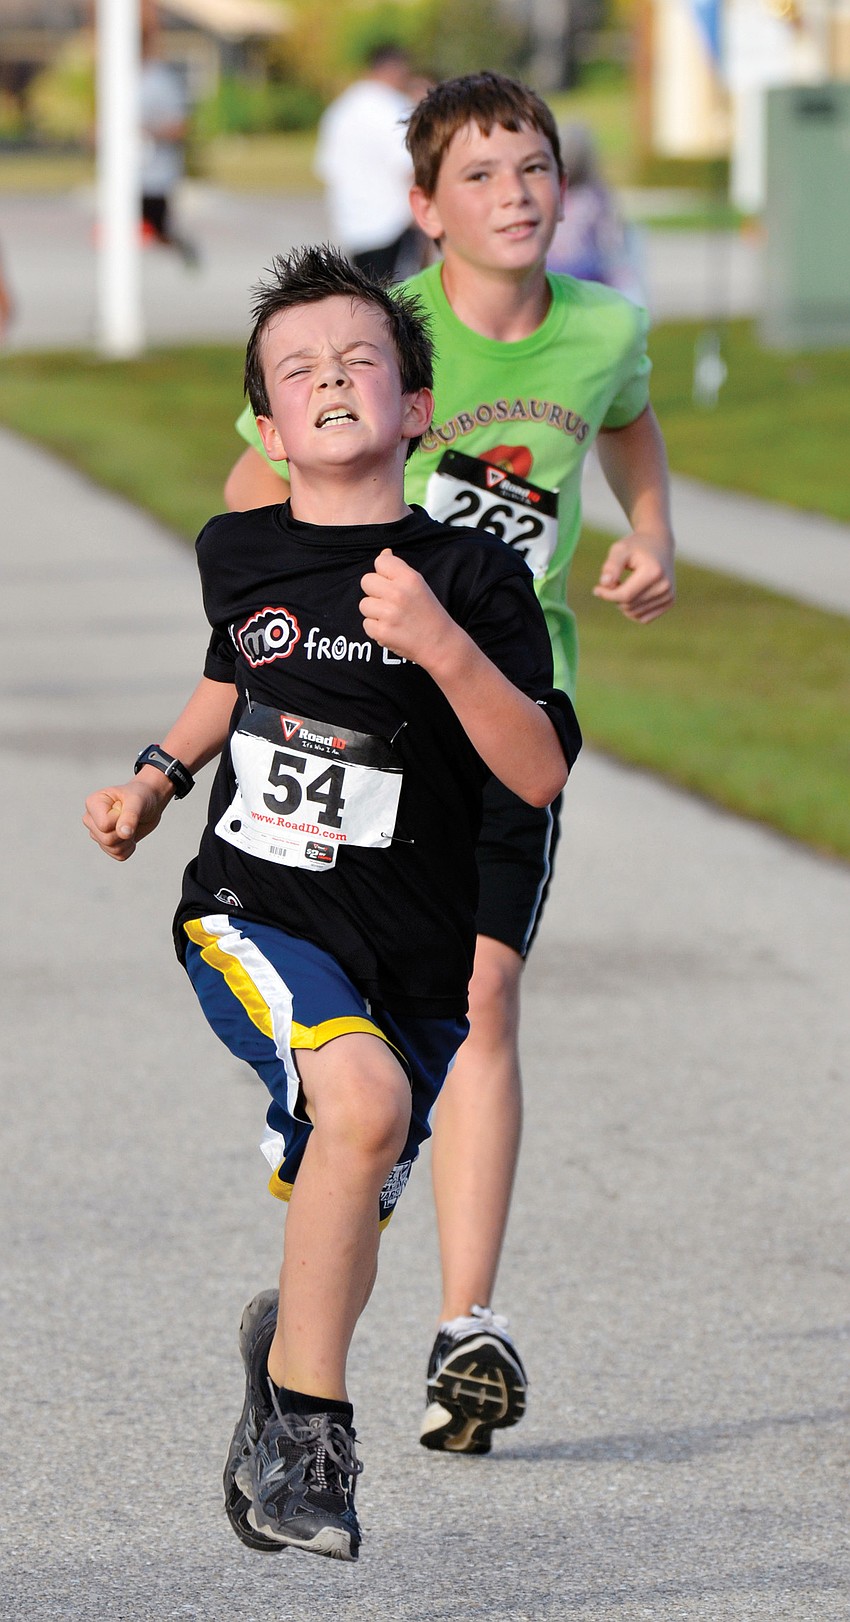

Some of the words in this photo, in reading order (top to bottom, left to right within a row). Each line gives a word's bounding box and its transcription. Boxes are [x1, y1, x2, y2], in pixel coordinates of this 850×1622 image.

[420, 399, 590, 453] CUBOSAURUS
[443, 490, 544, 559] 262
[263, 750, 346, 829] 54
[250, 811, 347, 841] www.RoadID.com
